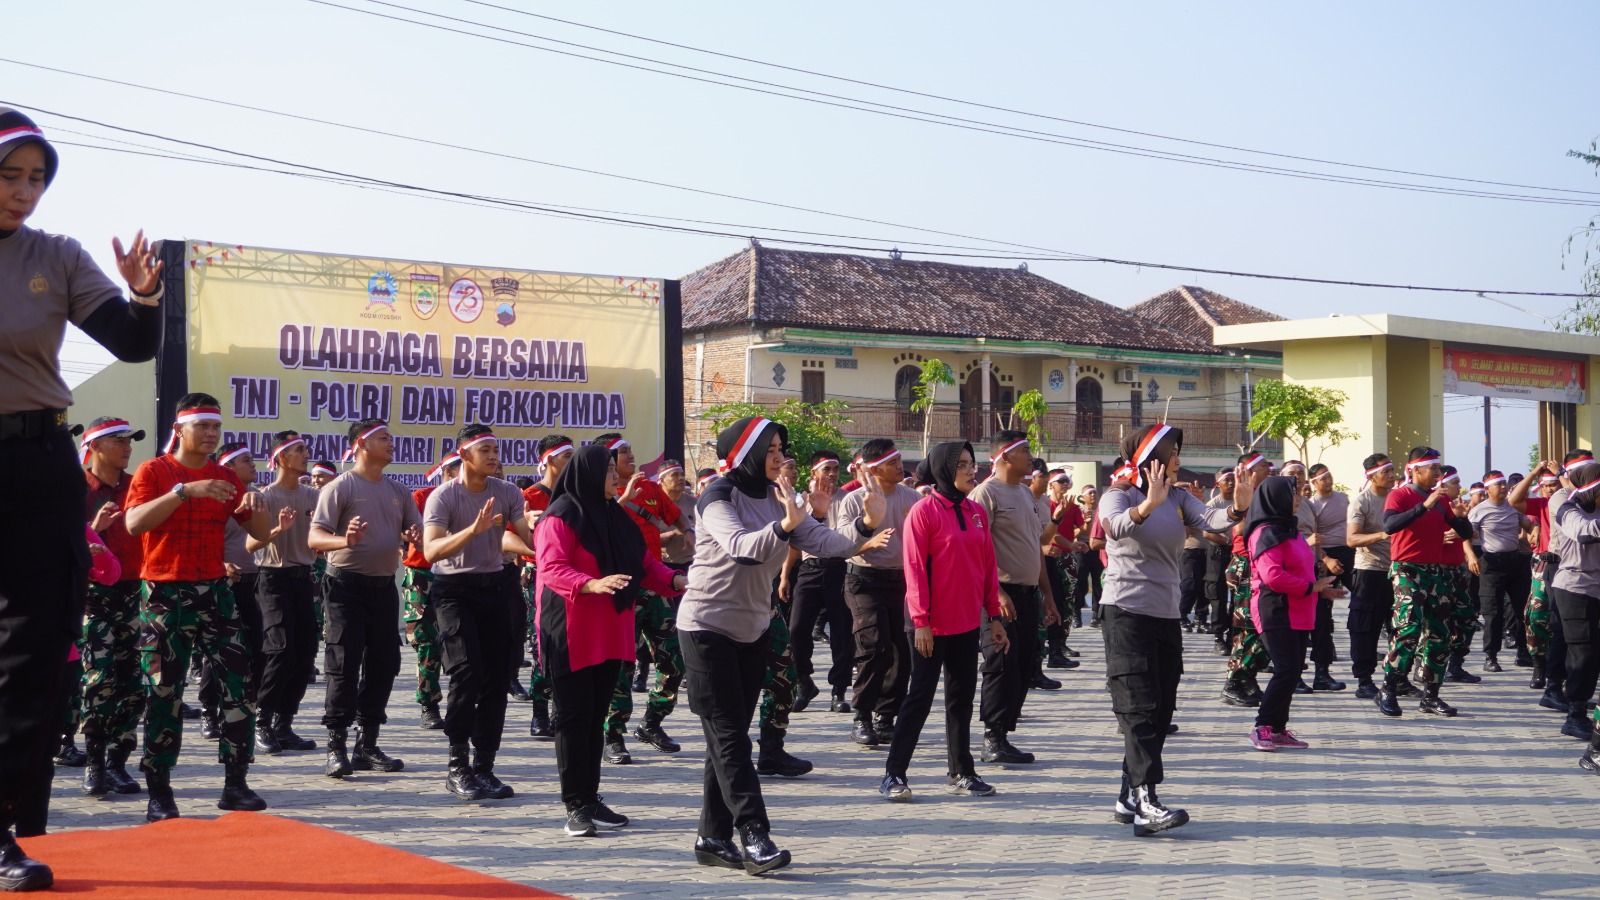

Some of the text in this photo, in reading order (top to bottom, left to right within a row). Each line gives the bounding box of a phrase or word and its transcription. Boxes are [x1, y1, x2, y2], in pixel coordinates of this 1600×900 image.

[278, 323, 588, 382] OLAHRAGA BERSAMA
[230, 376, 279, 418] TNI
[309, 380, 392, 421] POLRI
[401, 385, 456, 425] DAN
[464, 387, 626, 429] FORKOPIMDA
[223, 430, 279, 461] DALA
